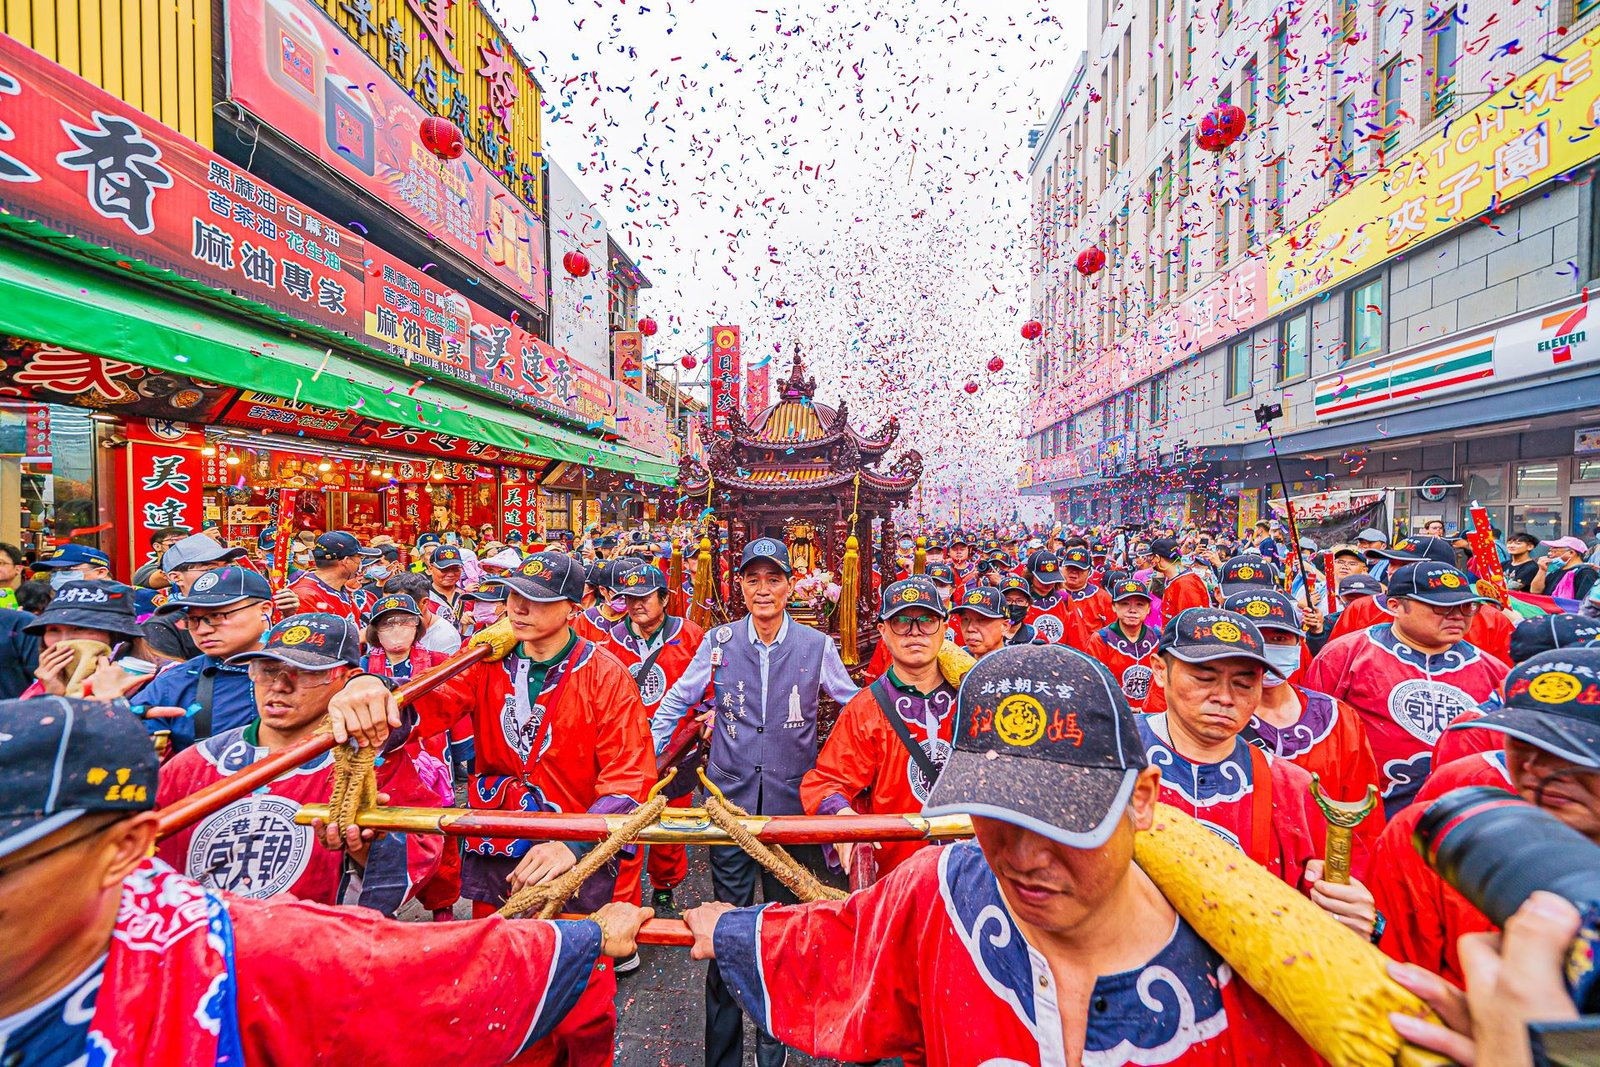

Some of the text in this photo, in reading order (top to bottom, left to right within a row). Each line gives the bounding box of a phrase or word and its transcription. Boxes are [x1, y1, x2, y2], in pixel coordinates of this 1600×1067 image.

[1387, 51, 1593, 196] CATCH ME
[1386, 120, 1551, 246] 夾子園
[192, 216, 347, 316] 麻油專家
[208, 190, 341, 272] 苦茶油·花生油
[376, 304, 463, 364] 麻油專家
[482, 323, 572, 403] 美達香
[1541, 304, 1588, 364] 7
[736, 680, 748, 718] 董事長
[980, 677, 1076, 700] 北港朝天宮
